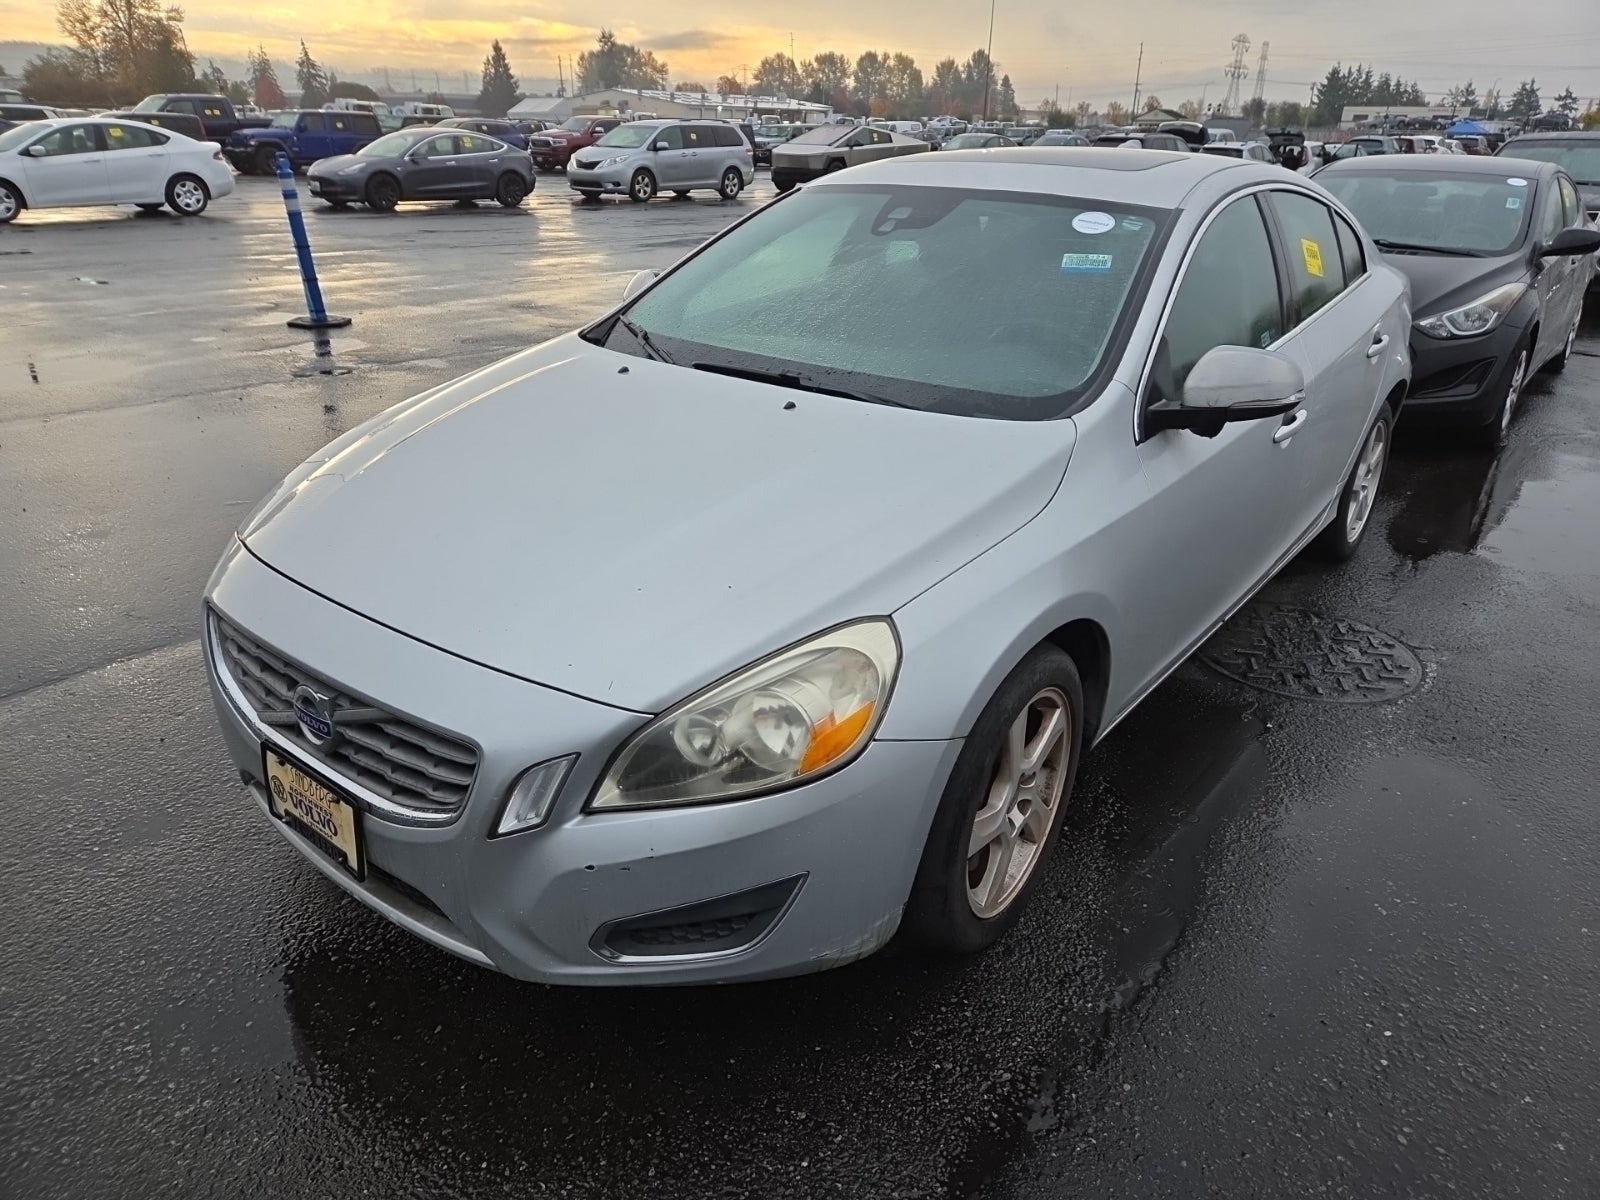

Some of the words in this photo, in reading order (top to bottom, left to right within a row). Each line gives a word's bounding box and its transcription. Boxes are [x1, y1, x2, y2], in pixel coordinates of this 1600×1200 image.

[295, 708, 328, 733] VOLVO
[289, 785, 333, 818] NORTHWEST
[290, 768, 333, 809] SANDBERG
[287, 791, 338, 837] VOLVO
